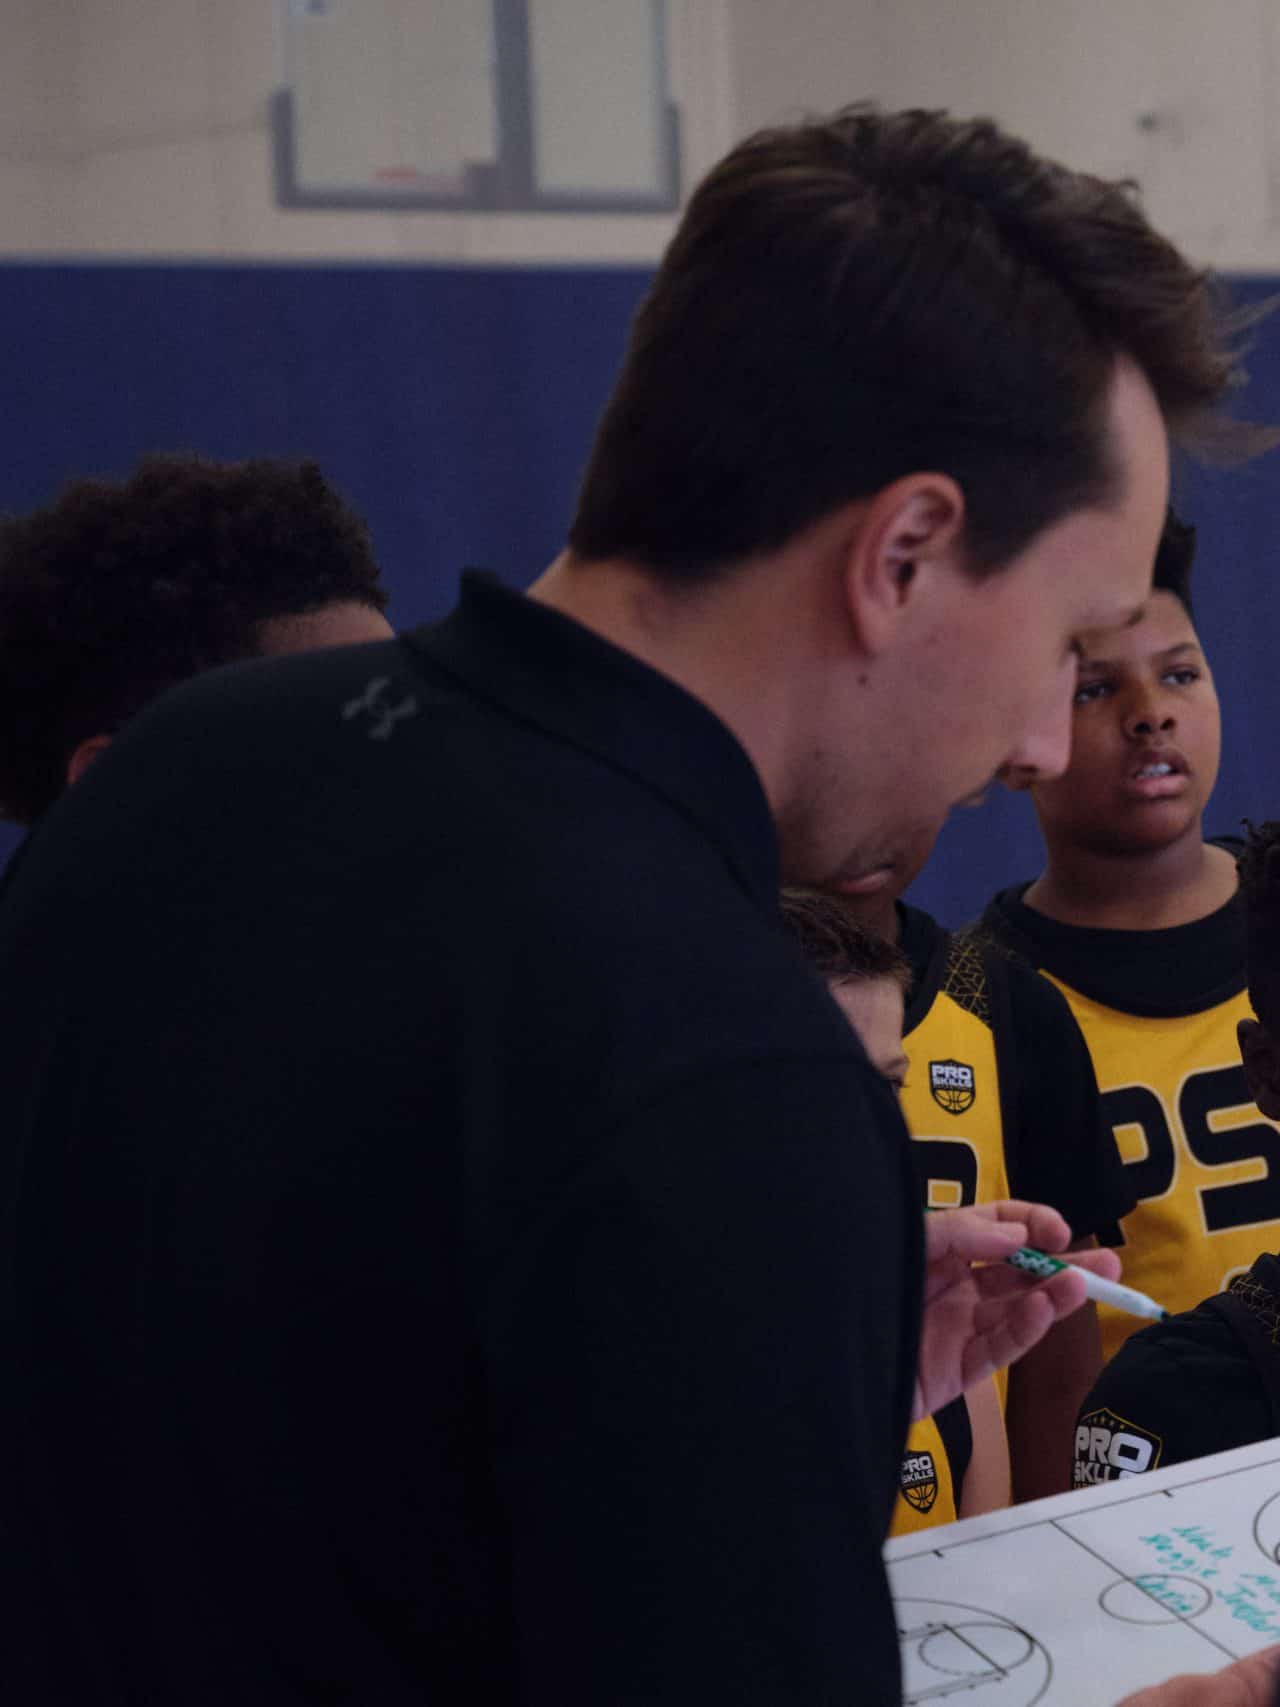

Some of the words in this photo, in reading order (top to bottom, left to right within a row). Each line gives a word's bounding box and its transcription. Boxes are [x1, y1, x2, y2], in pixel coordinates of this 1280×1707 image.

[931, 1064, 972, 1080] PRO
[932, 1077, 973, 1088] SKILLS
[1074, 1425, 1153, 1474] PRO
[903, 1468, 934, 1484] SKILLS
